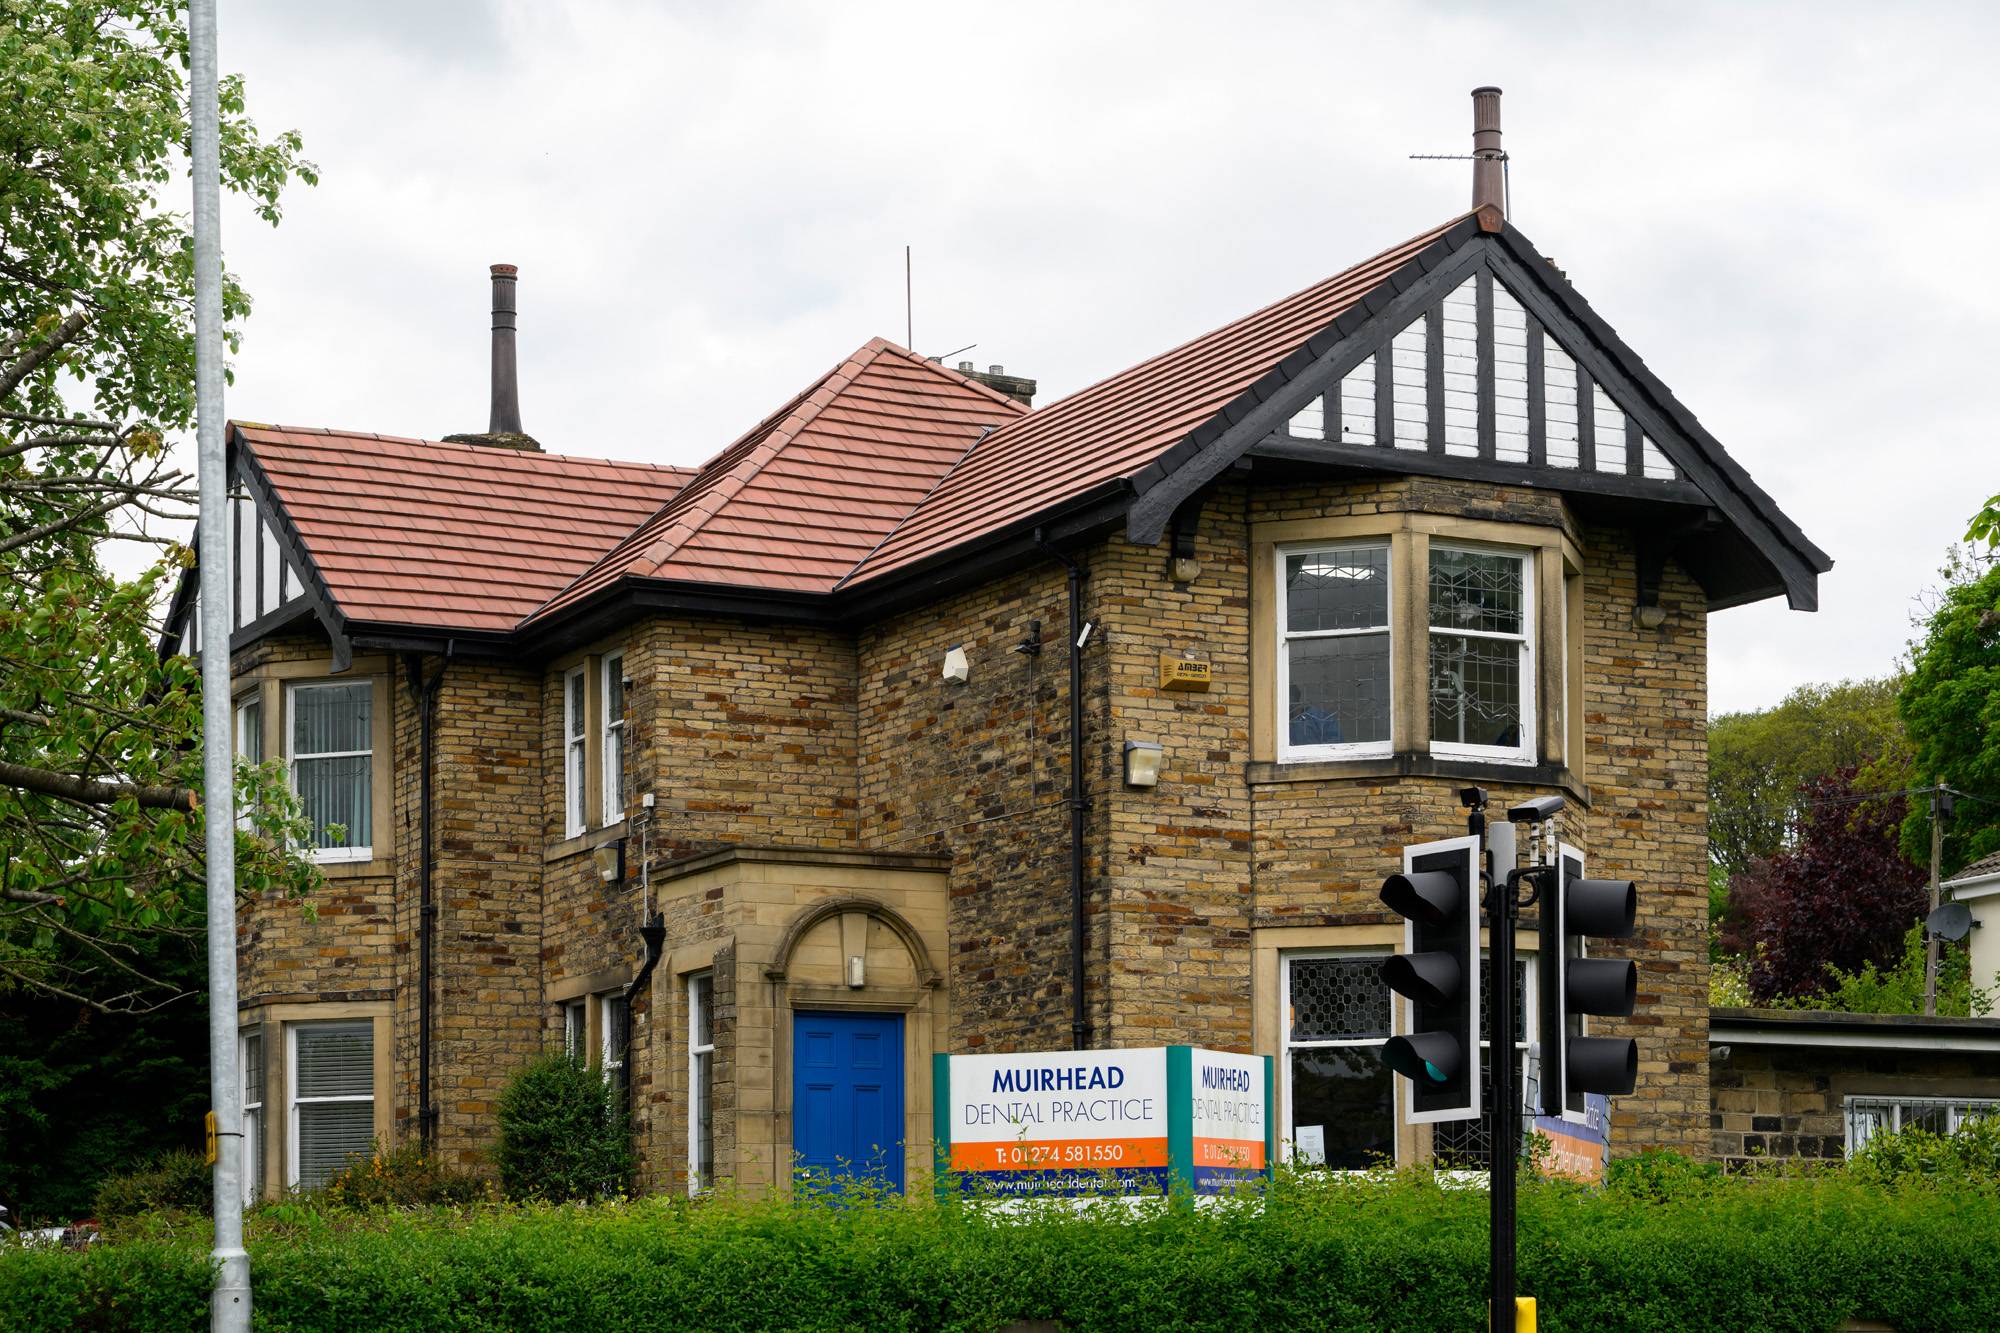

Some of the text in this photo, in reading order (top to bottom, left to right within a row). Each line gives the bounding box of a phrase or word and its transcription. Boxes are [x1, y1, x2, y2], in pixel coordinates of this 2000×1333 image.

[1178, 662, 1208, 673] AMBER
[992, 1066, 1125, 1093] MUIRHEAD
[1202, 1065, 1250, 1092] MUIRHEAD
[965, 1098, 1153, 1125] DENTAL PRACTICE
[1192, 1098, 1260, 1124] DENTAL PRACTICE
[995, 1144, 1123, 1163] T: 01274 581550
